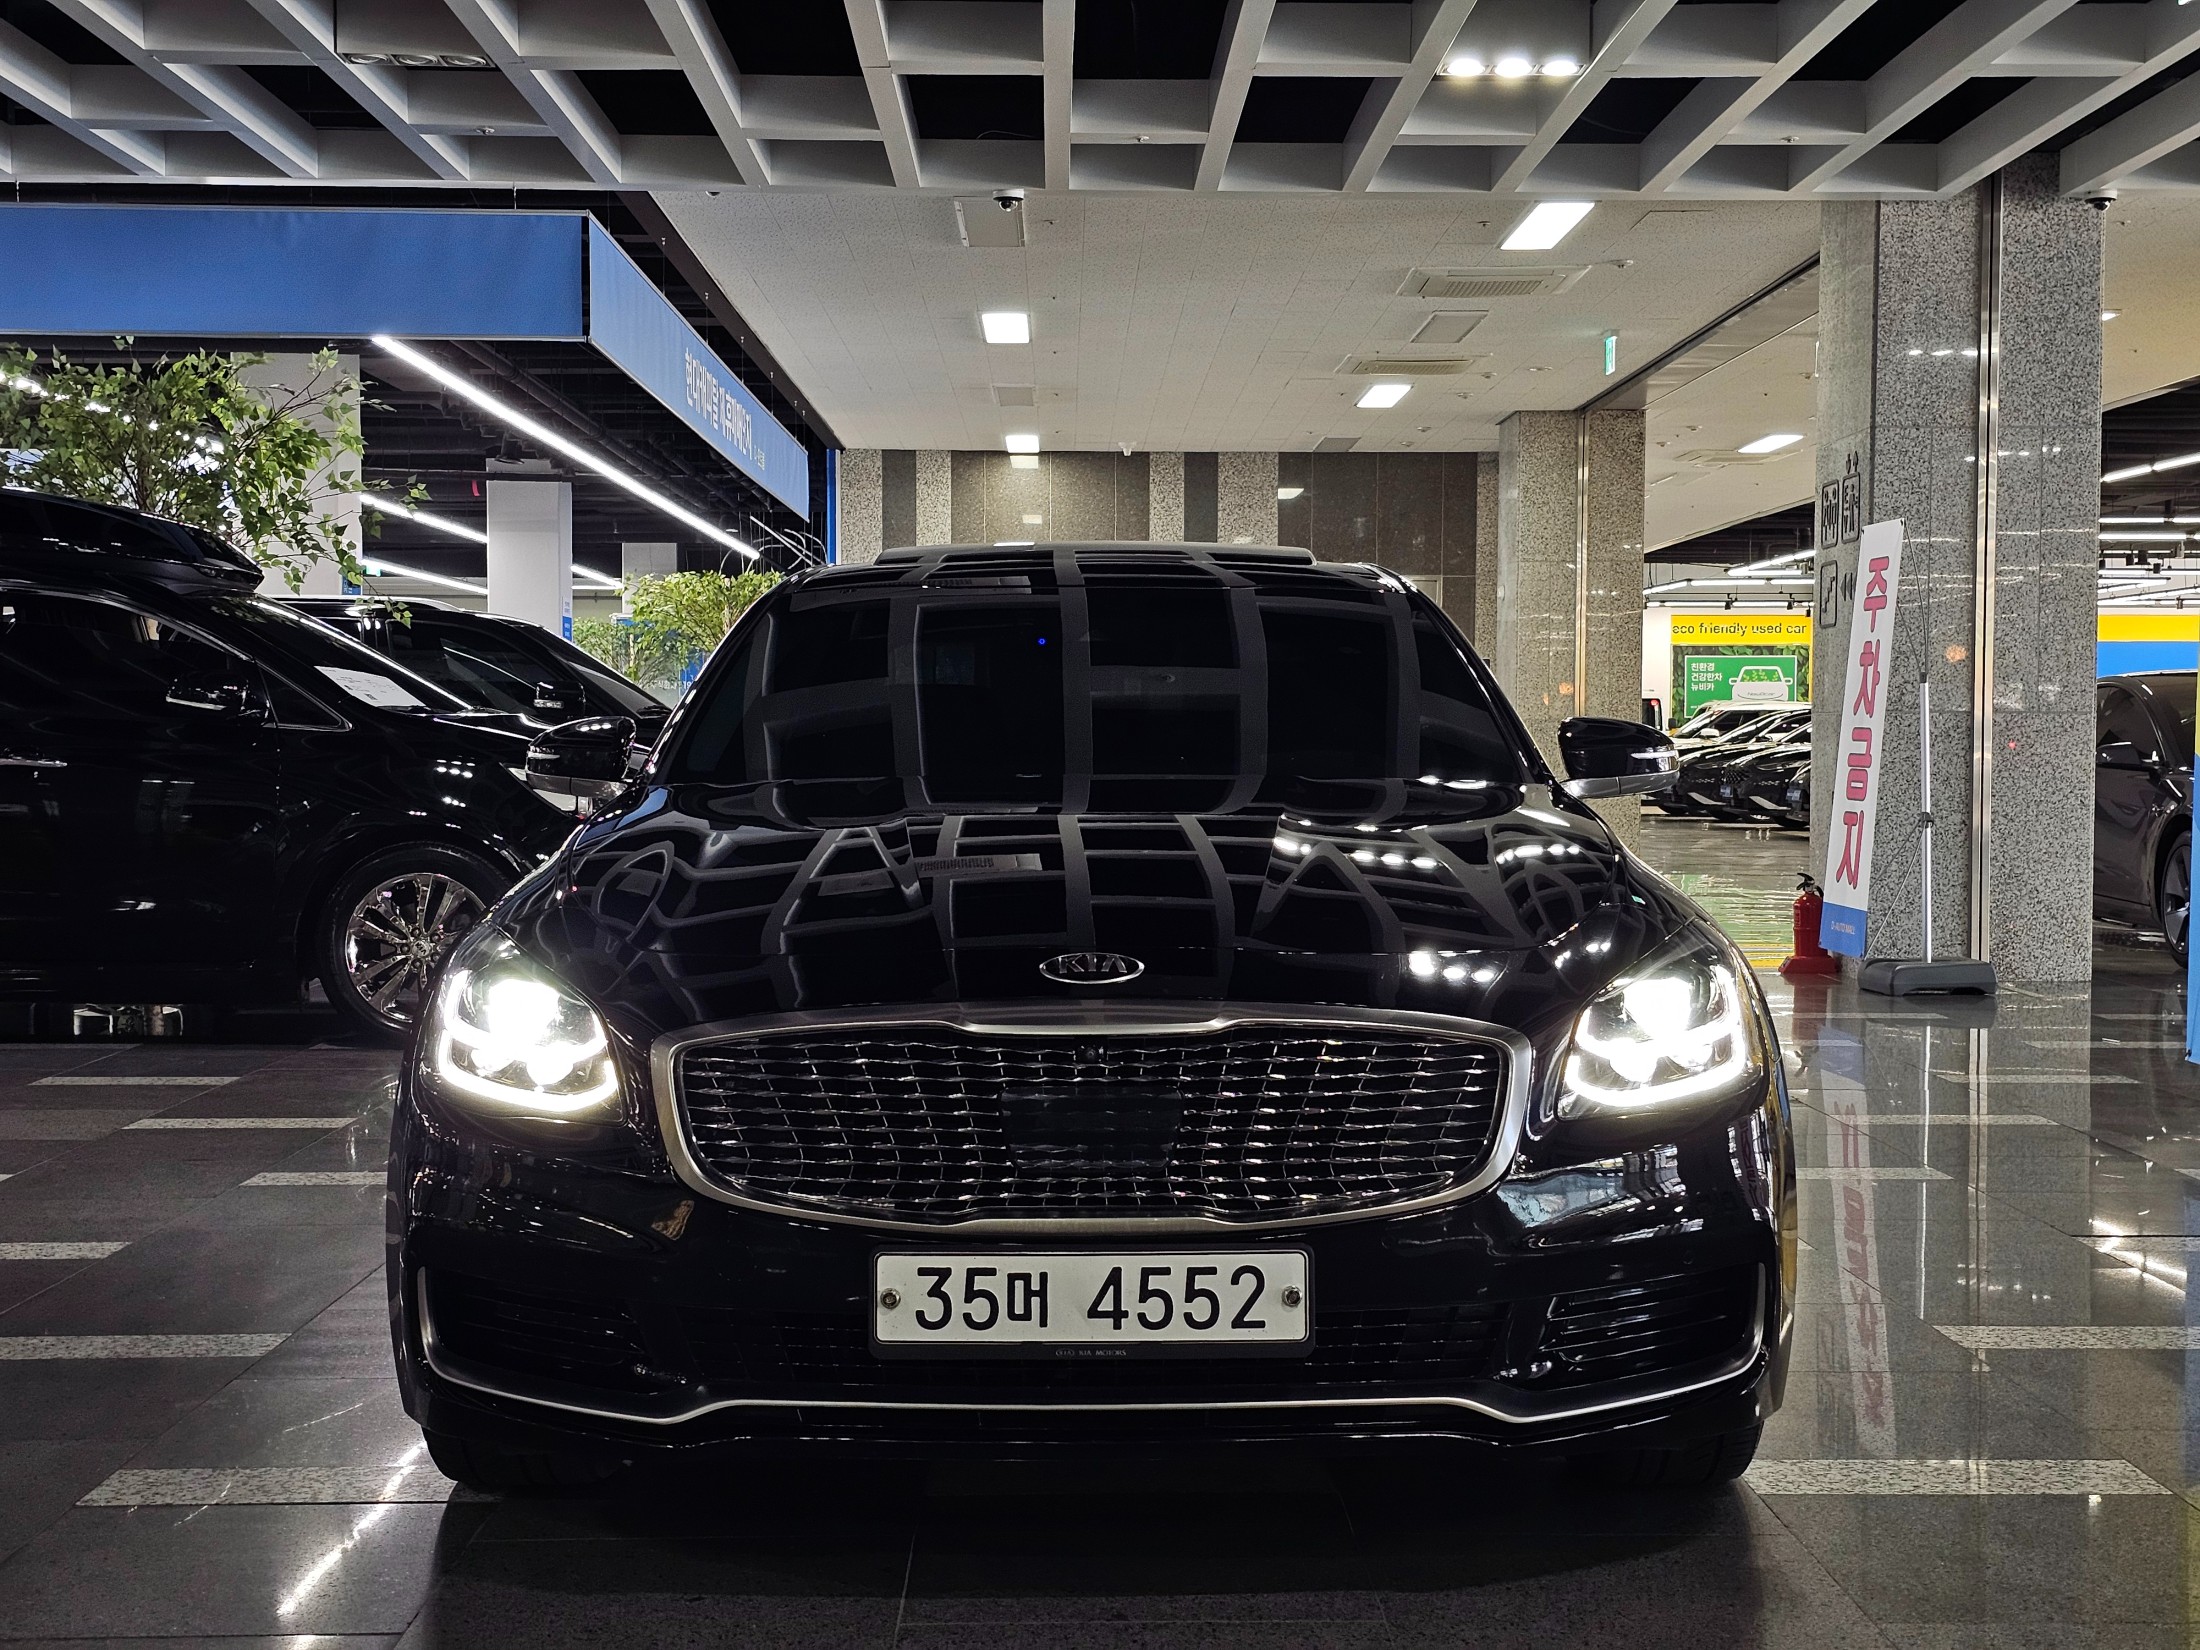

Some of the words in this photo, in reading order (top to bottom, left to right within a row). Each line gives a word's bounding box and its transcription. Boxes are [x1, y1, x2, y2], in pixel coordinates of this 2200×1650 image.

[1672, 624, 1695, 634] eco
[1699, 622, 1747, 636] friendly
[1752, 623, 1782, 634] used
[1786, 624, 1807, 634] car
[1691, 662, 1715, 672] 친환경
[1691, 672, 1722, 682] 건강한차
[1691, 682, 1715, 691] 뉴비카
[1835, 556, 1890, 889] 주차금지
[1057, 953, 1128, 974] KIA
[915, 1266, 1049, 1331] 35머
[1086, 1265, 1267, 1331] 4552
